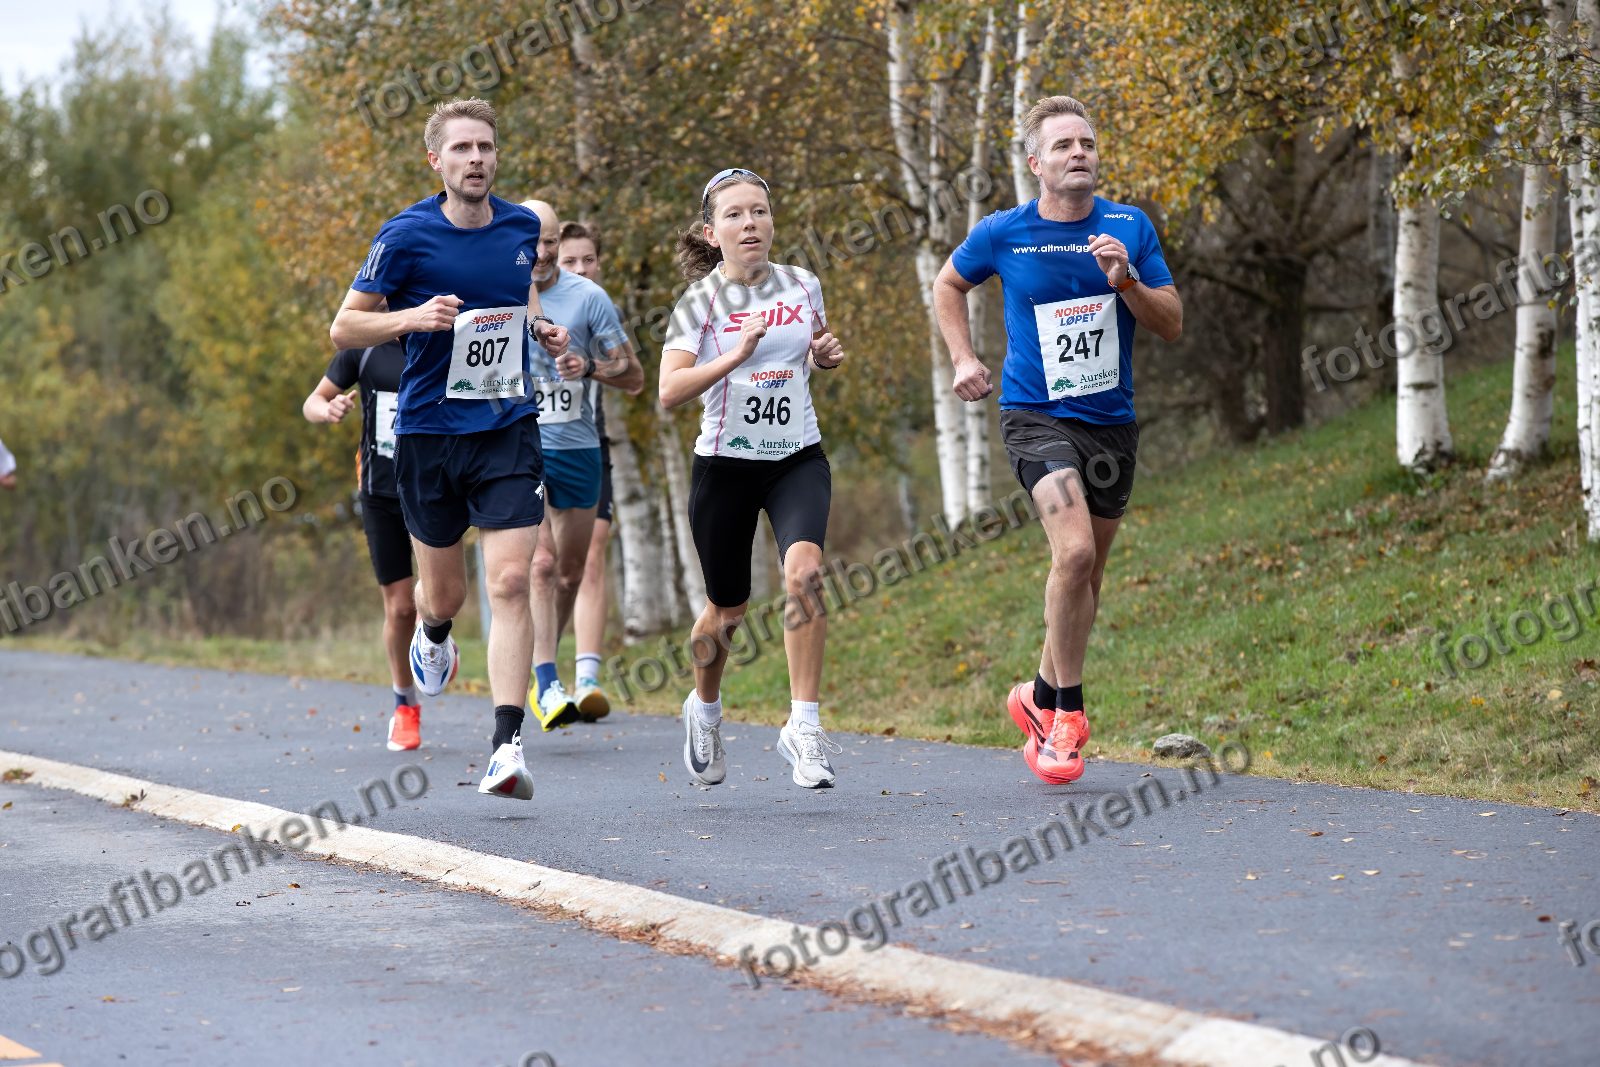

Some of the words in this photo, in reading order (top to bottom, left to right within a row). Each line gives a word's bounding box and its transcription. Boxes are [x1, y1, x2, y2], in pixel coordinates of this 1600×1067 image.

[1054, 303, 1103, 318] NORGES
[472, 313, 514, 325] NORGES
[1059, 313, 1097, 327] LØPET
[475, 321, 506, 333] LØPET
[466, 337, 510, 367] 807
[1056, 329, 1104, 363] 247
[480, 376, 520, 389] Aurskog
[750, 370, 794, 382] NORGES
[1080, 369, 1118, 386] Aurskog
[756, 379, 788, 389] LØPET
[535, 389, 572, 411] 219
[743, 396, 791, 426] 346
[758, 439, 800, 452] Aurskog
